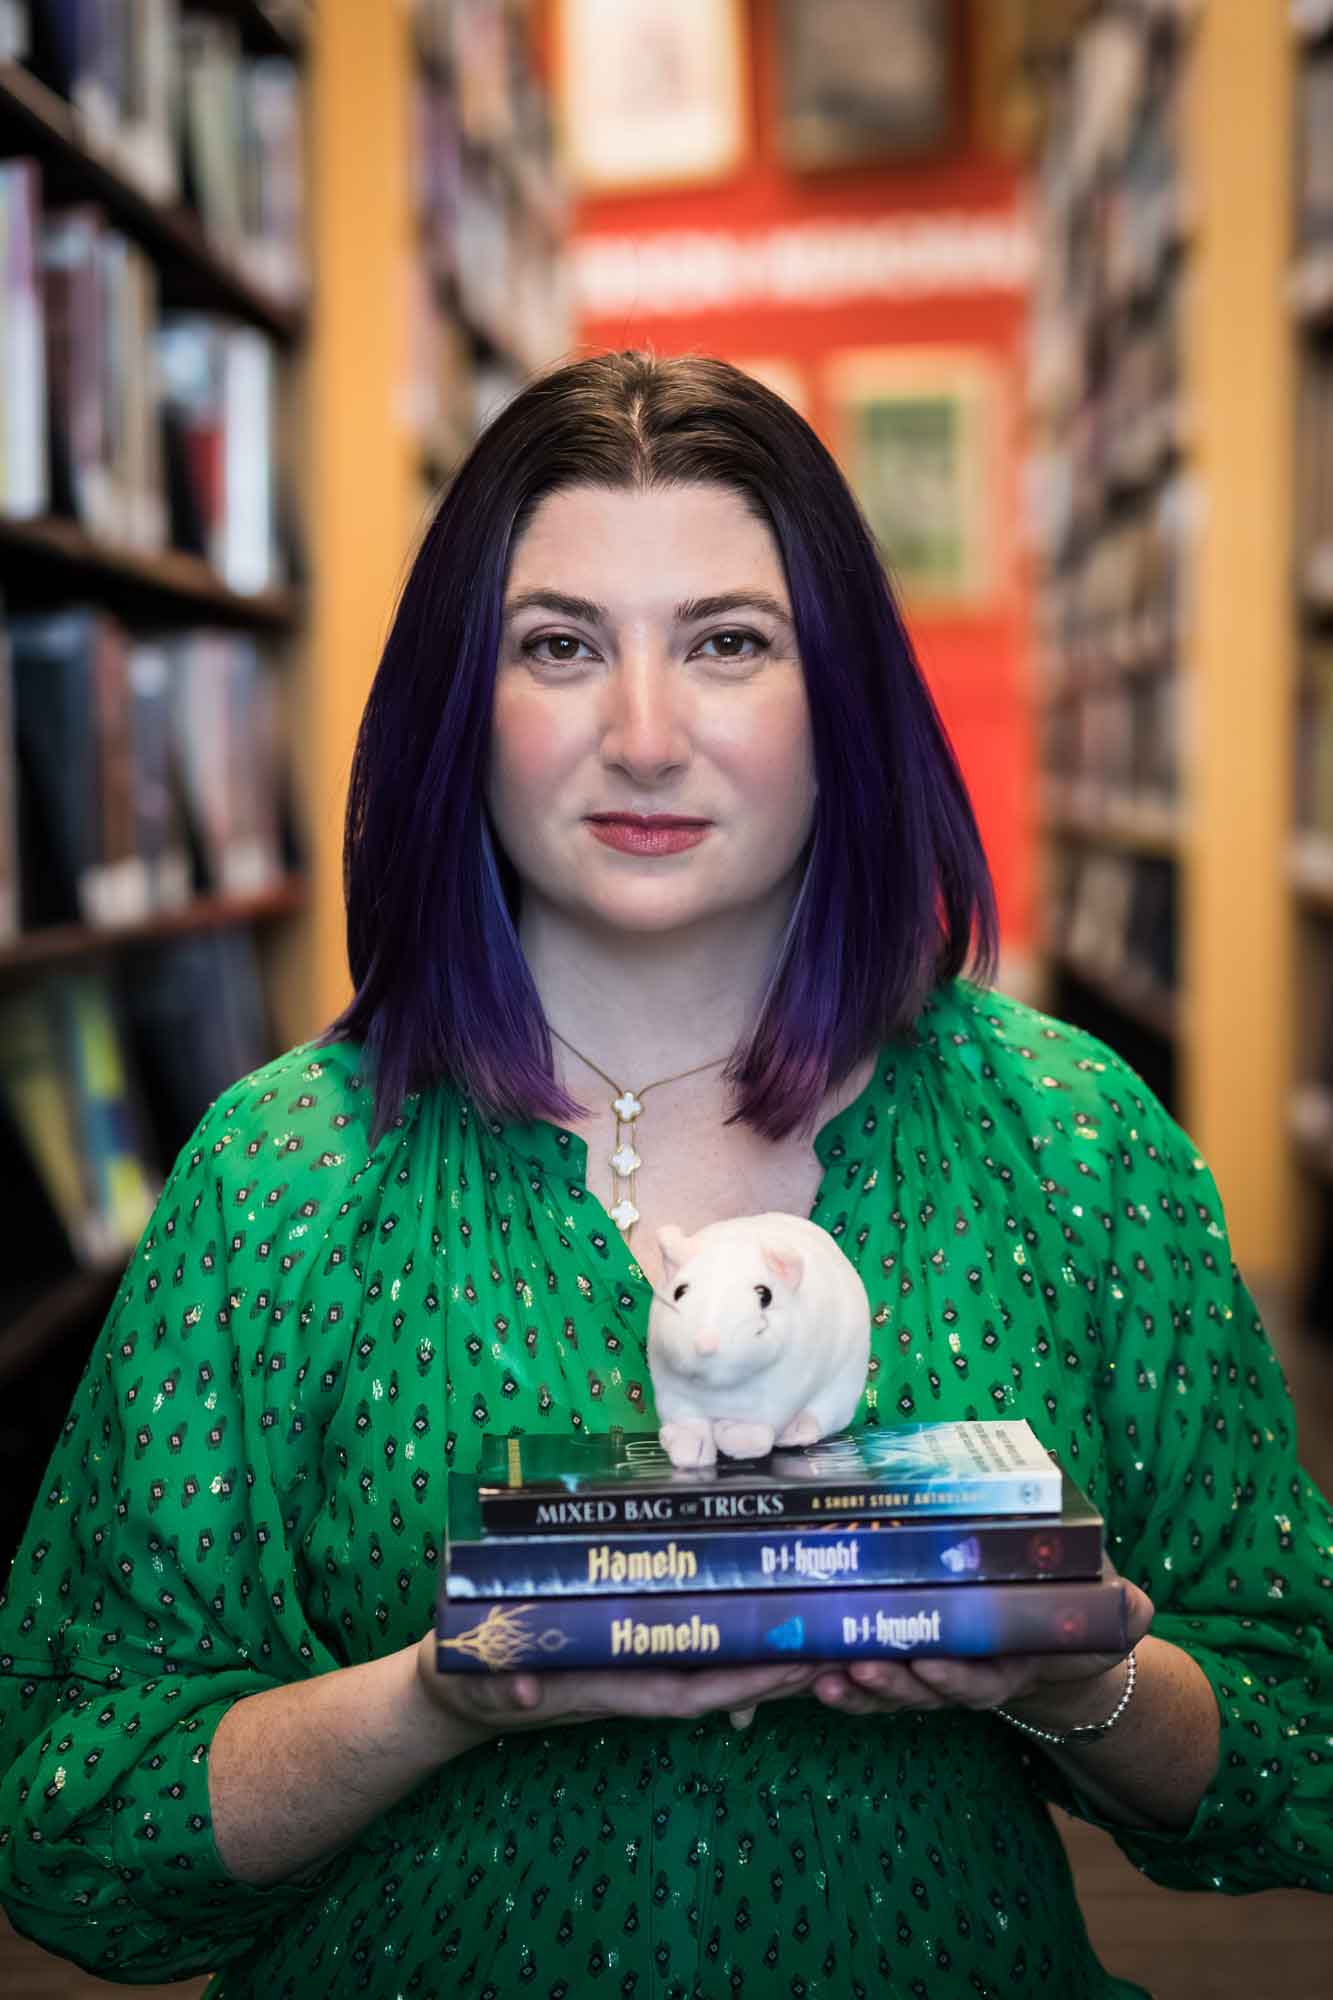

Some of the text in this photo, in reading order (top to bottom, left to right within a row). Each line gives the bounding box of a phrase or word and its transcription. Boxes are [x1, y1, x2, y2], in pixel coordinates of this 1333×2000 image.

[536, 1501, 616, 1524] MIXED
[624, 1499, 672, 1520] BAG
[700, 1493, 784, 1517] TRICKS
[811, 1497, 821, 1509] A
[824, 1495, 865, 1509] SHORT
[869, 1493, 909, 1507] STORY
[588, 1541, 697, 1583] Hameln
[611, 1615, 720, 1655] Hameln
